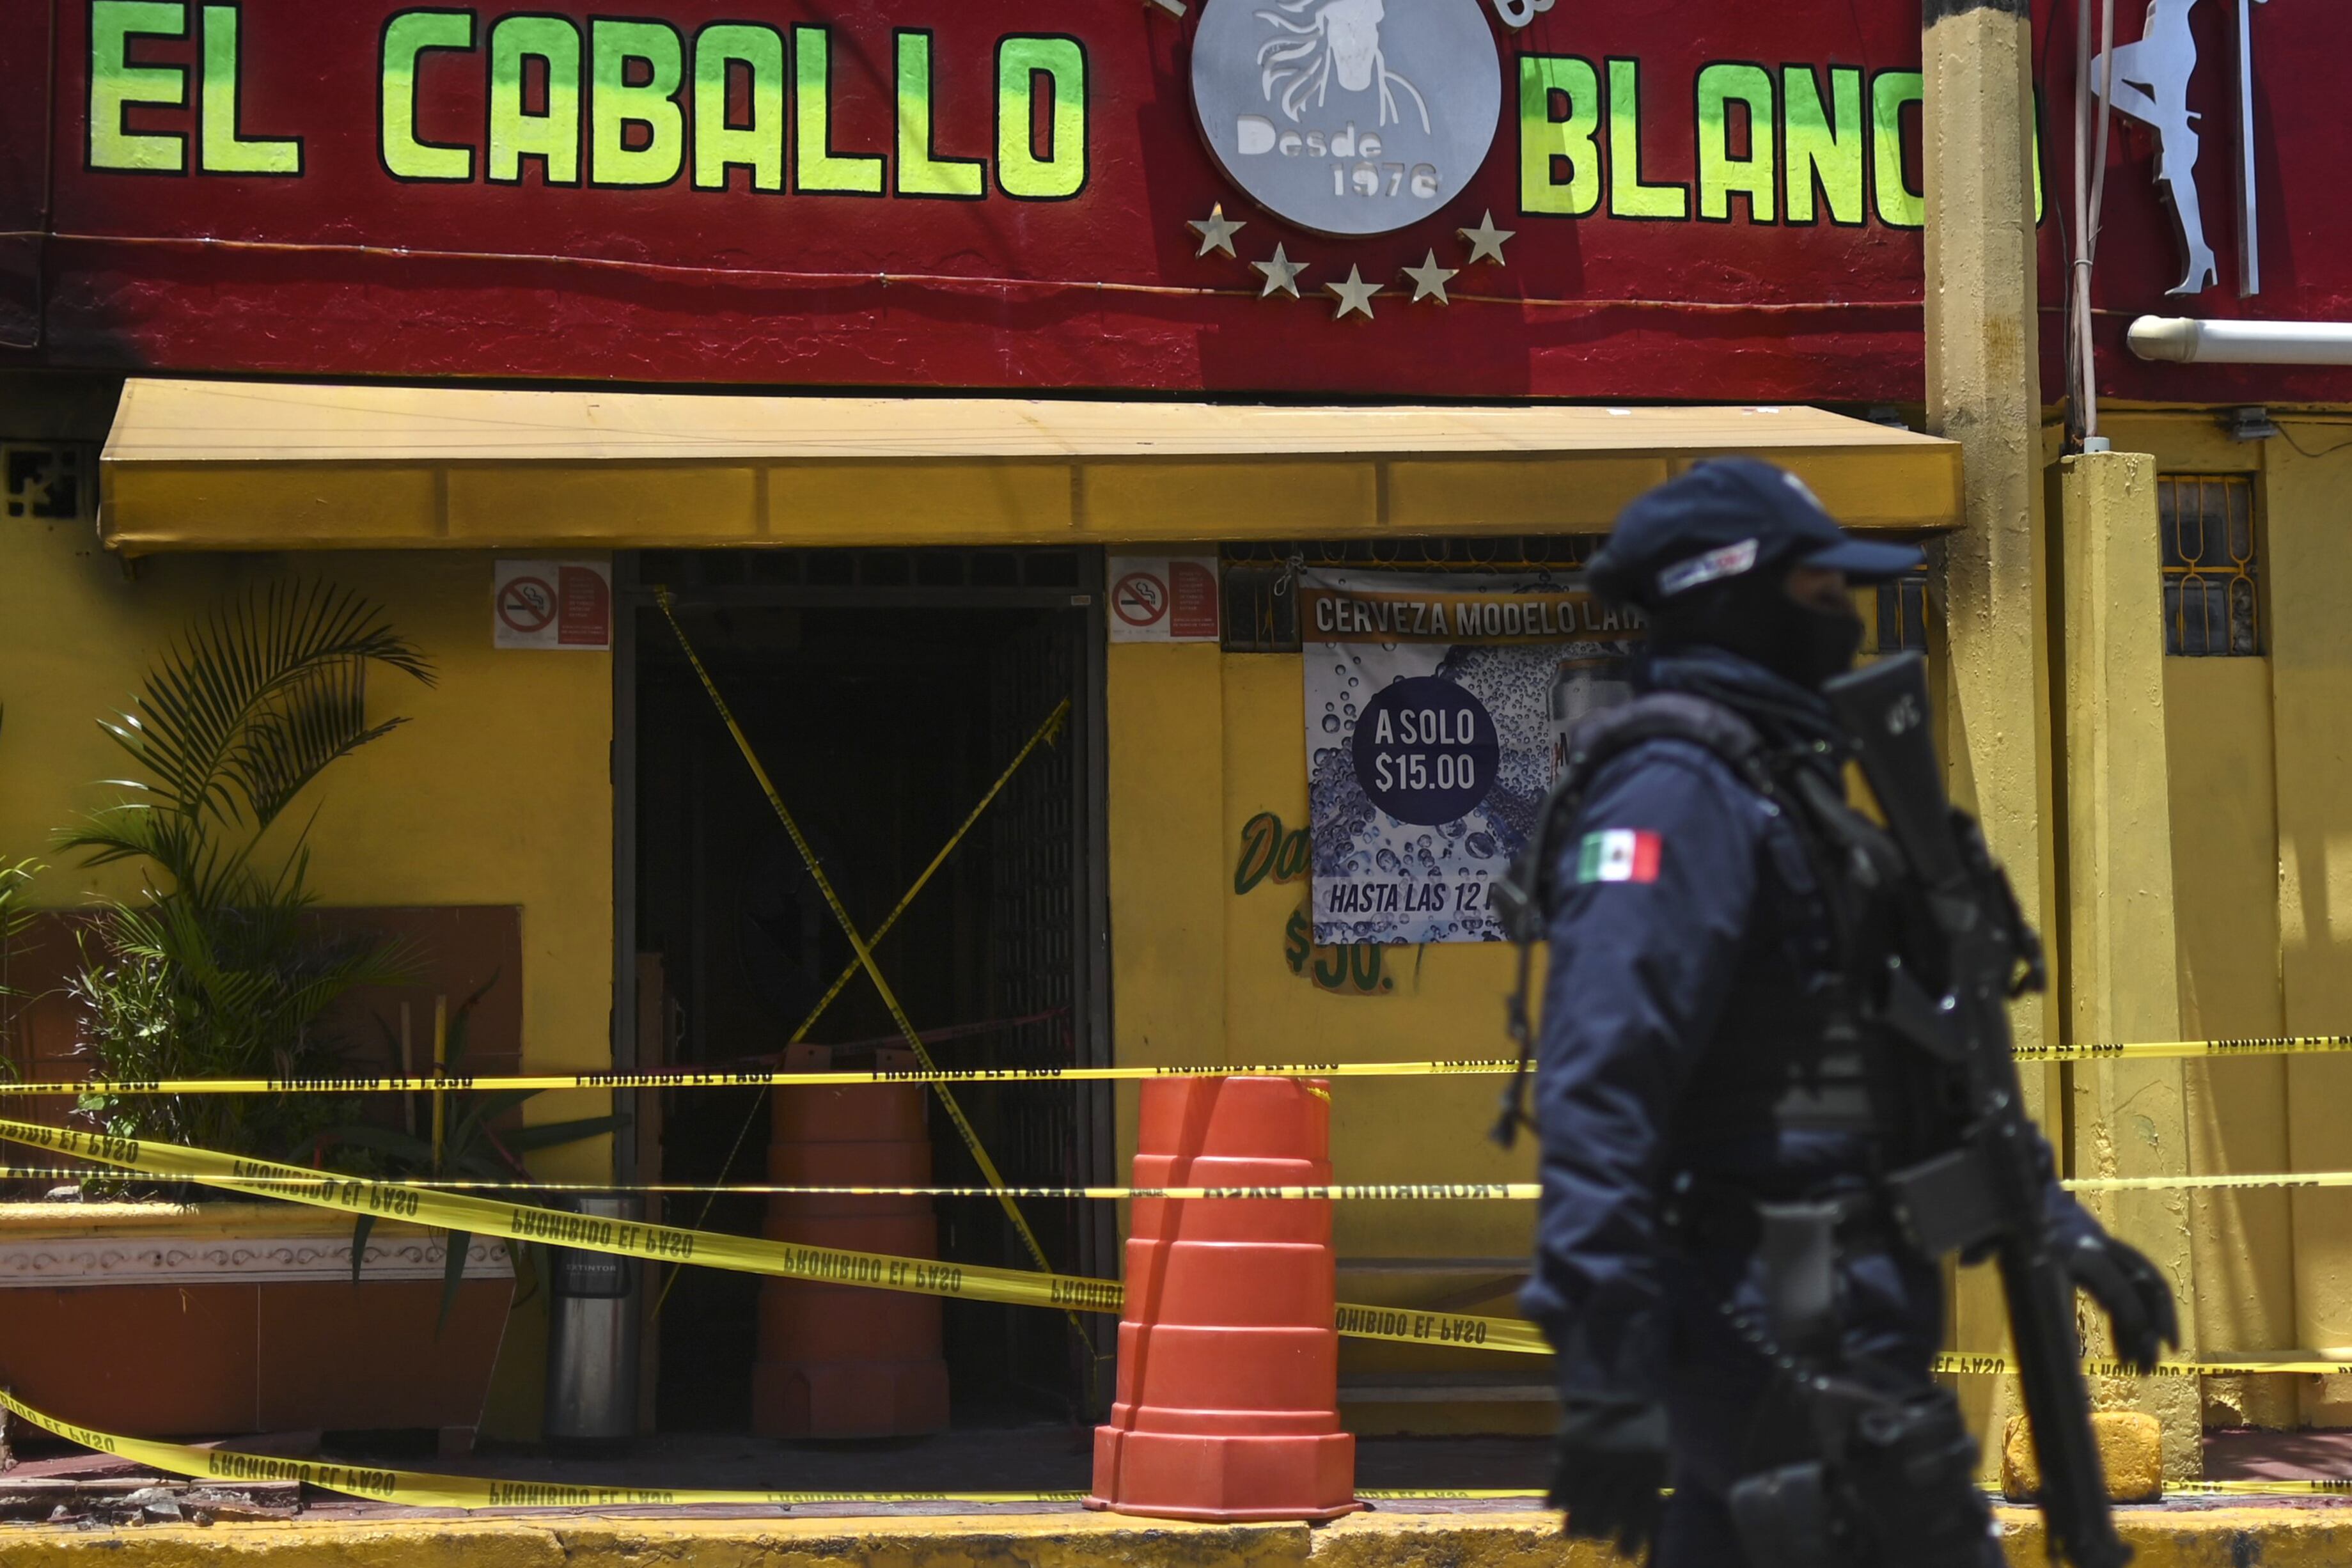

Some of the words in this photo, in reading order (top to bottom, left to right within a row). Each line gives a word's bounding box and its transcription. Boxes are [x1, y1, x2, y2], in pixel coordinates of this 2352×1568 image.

[84, 0, 304, 177] EL
[377, 6, 1087, 200] CABALLO
[1516, 51, 2047, 230] BLANC
[1237, 114, 1382, 158] Desde
[1329, 161, 1438, 199] 1976
[1315, 597, 1448, 636] CERVEZA
[1455, 600, 1577, 636] MODELO
[1375, 709, 1393, 745] A
[1400, 708, 1475, 745] SOLO
[1374, 753, 1475, 794] $15.00
[1330, 883, 1398, 913] HASTA
[1405, 882, 1446, 911] LAS
[1455, 882, 1482, 911] 12
